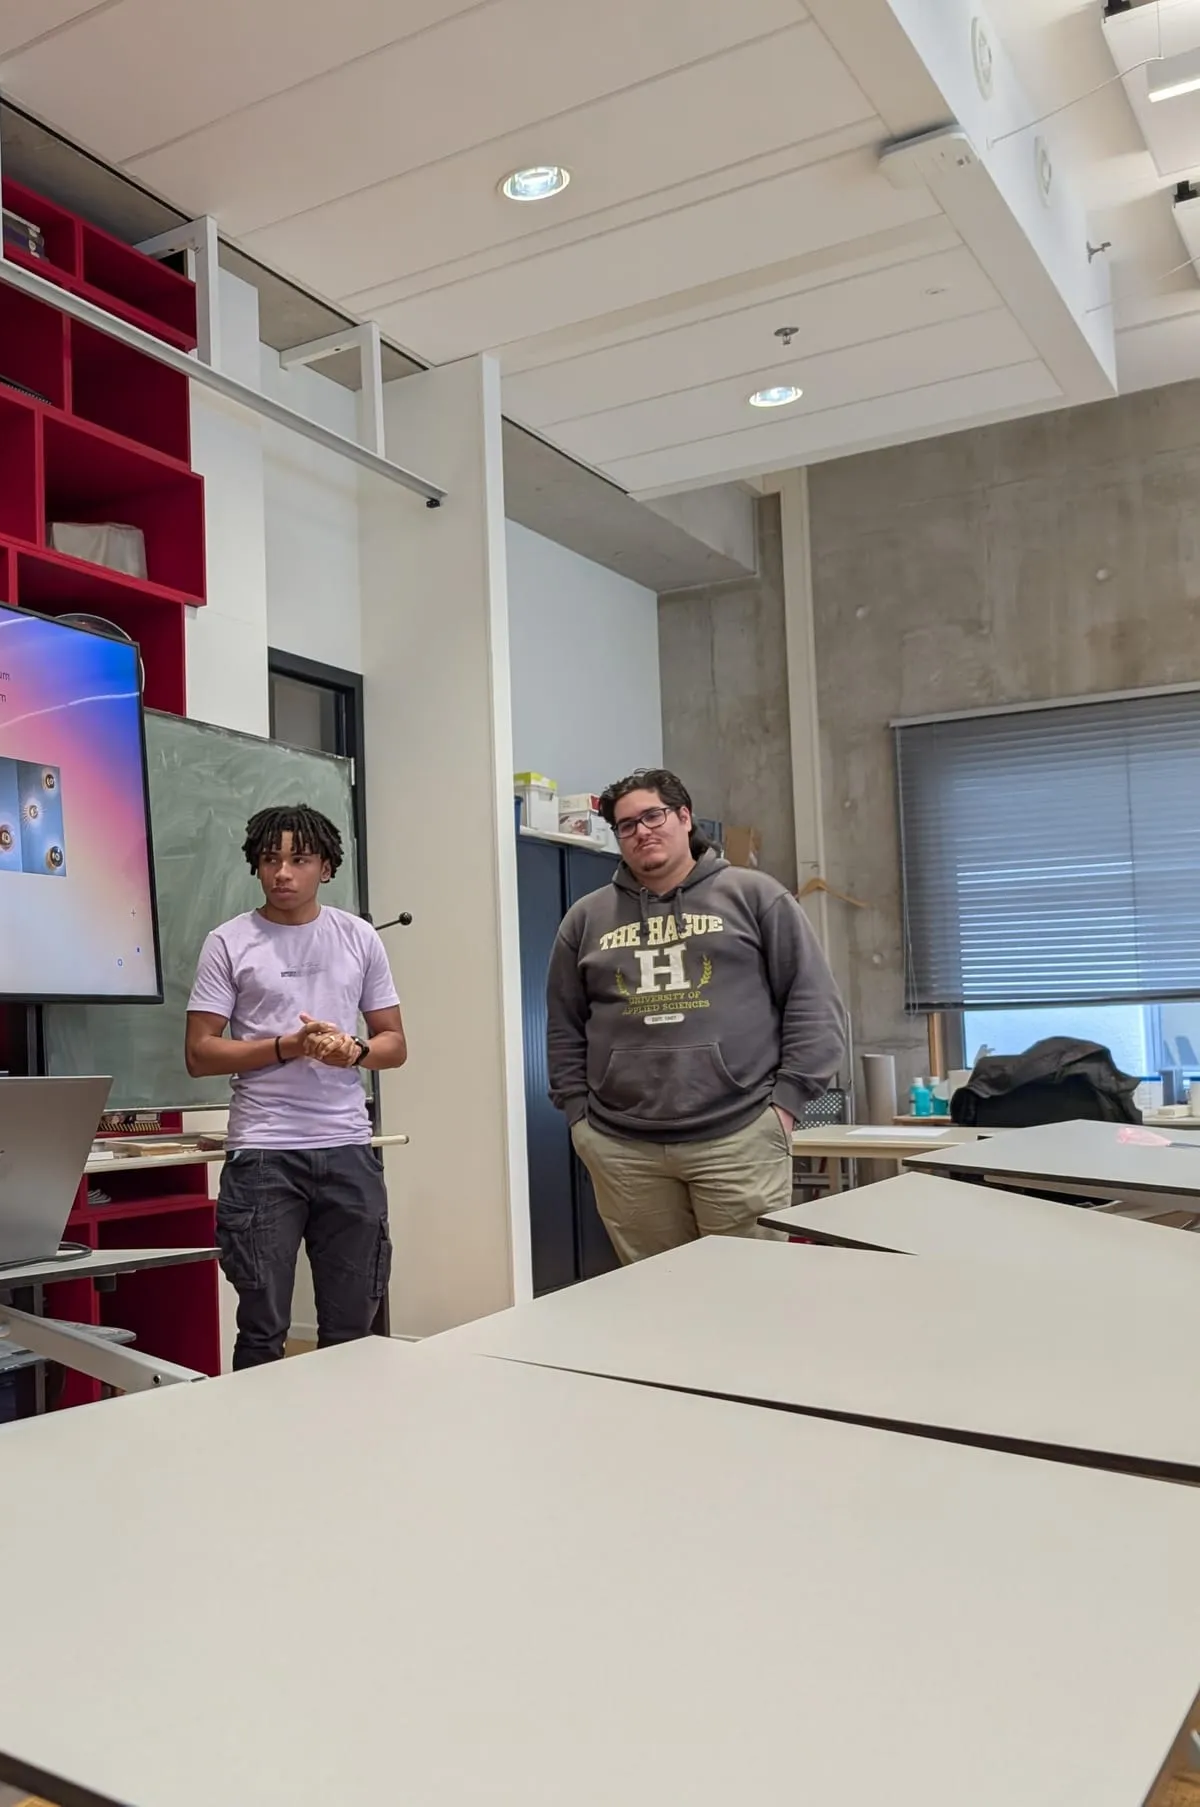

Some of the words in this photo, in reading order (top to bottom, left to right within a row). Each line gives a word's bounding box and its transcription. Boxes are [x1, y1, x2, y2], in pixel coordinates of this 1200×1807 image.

[599, 922, 641, 951] THE
[647, 913, 724, 946] HAGUE
[634, 942, 692, 994] H
[622, 1004, 660, 1016] APPLIED
[662, 999, 711, 1011] SCIENCES
[628, 992, 685, 1005] UNIVERSITY
[687, 991, 701, 1000] OF
